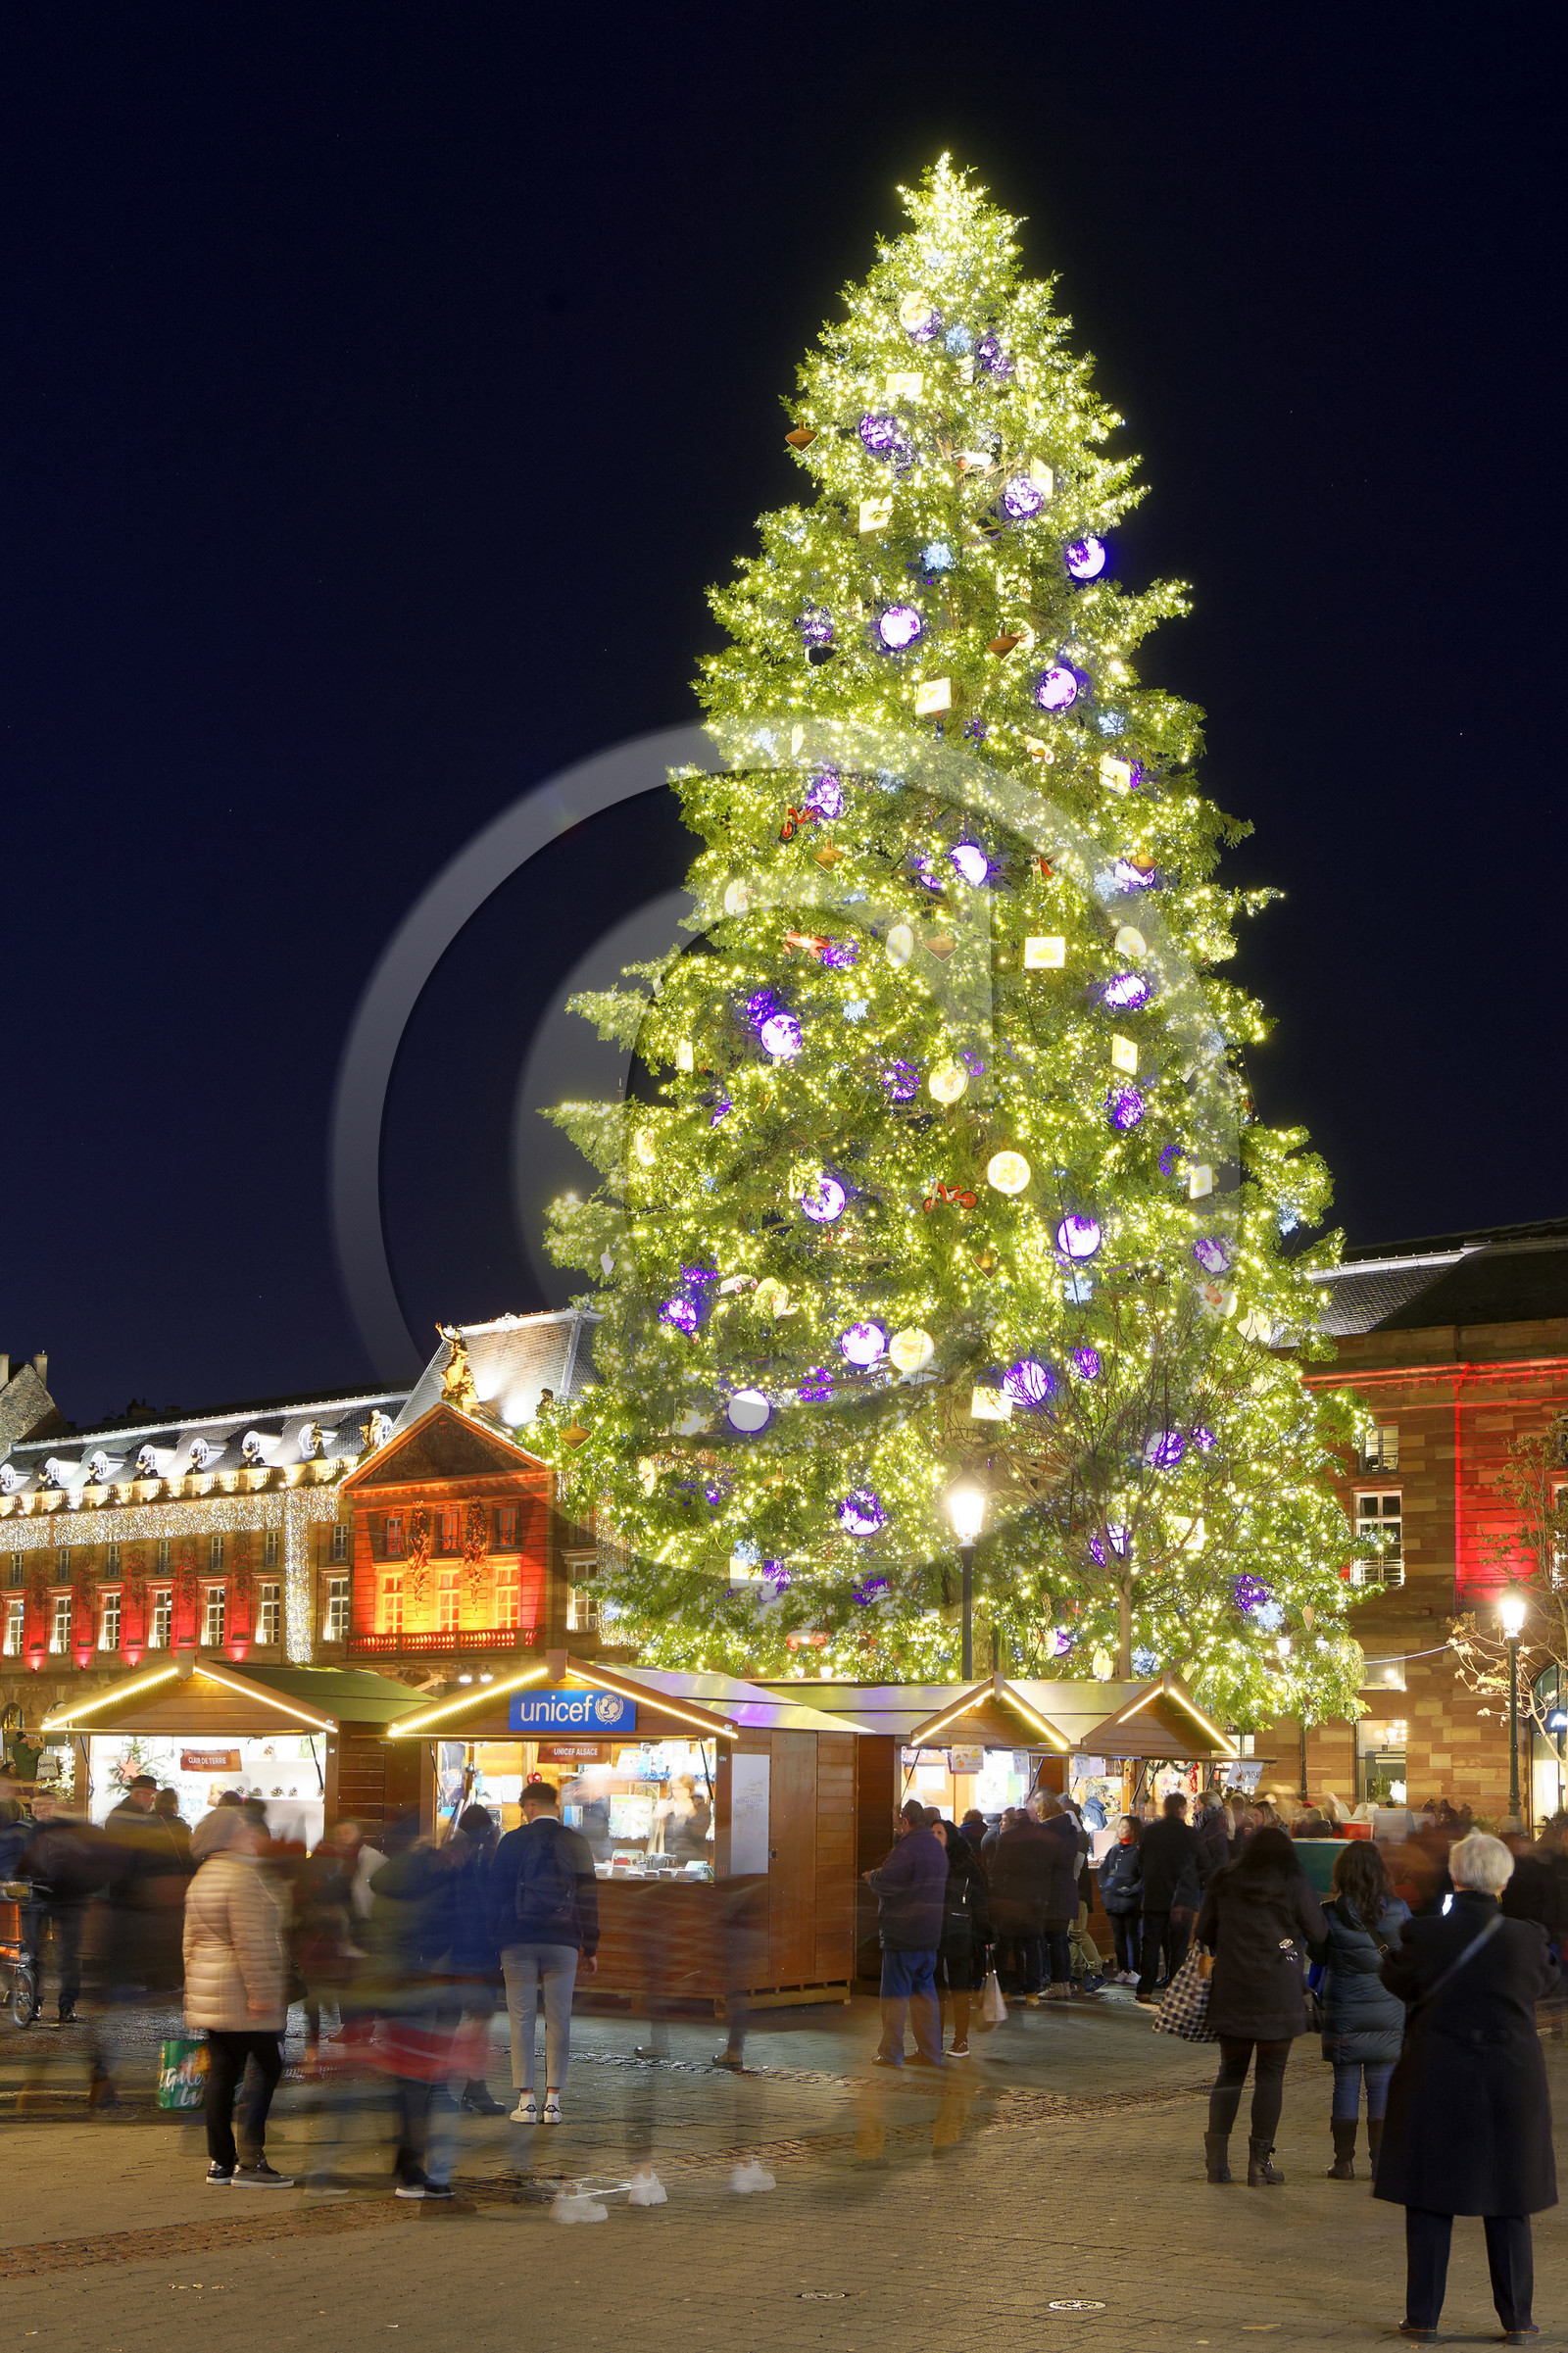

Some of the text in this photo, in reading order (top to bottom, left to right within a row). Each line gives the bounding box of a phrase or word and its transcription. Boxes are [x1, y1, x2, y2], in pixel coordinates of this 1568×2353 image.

[520, 1694, 594, 1722] unicef
[554, 1747, 598, 1756] UNICEF ALSACE
